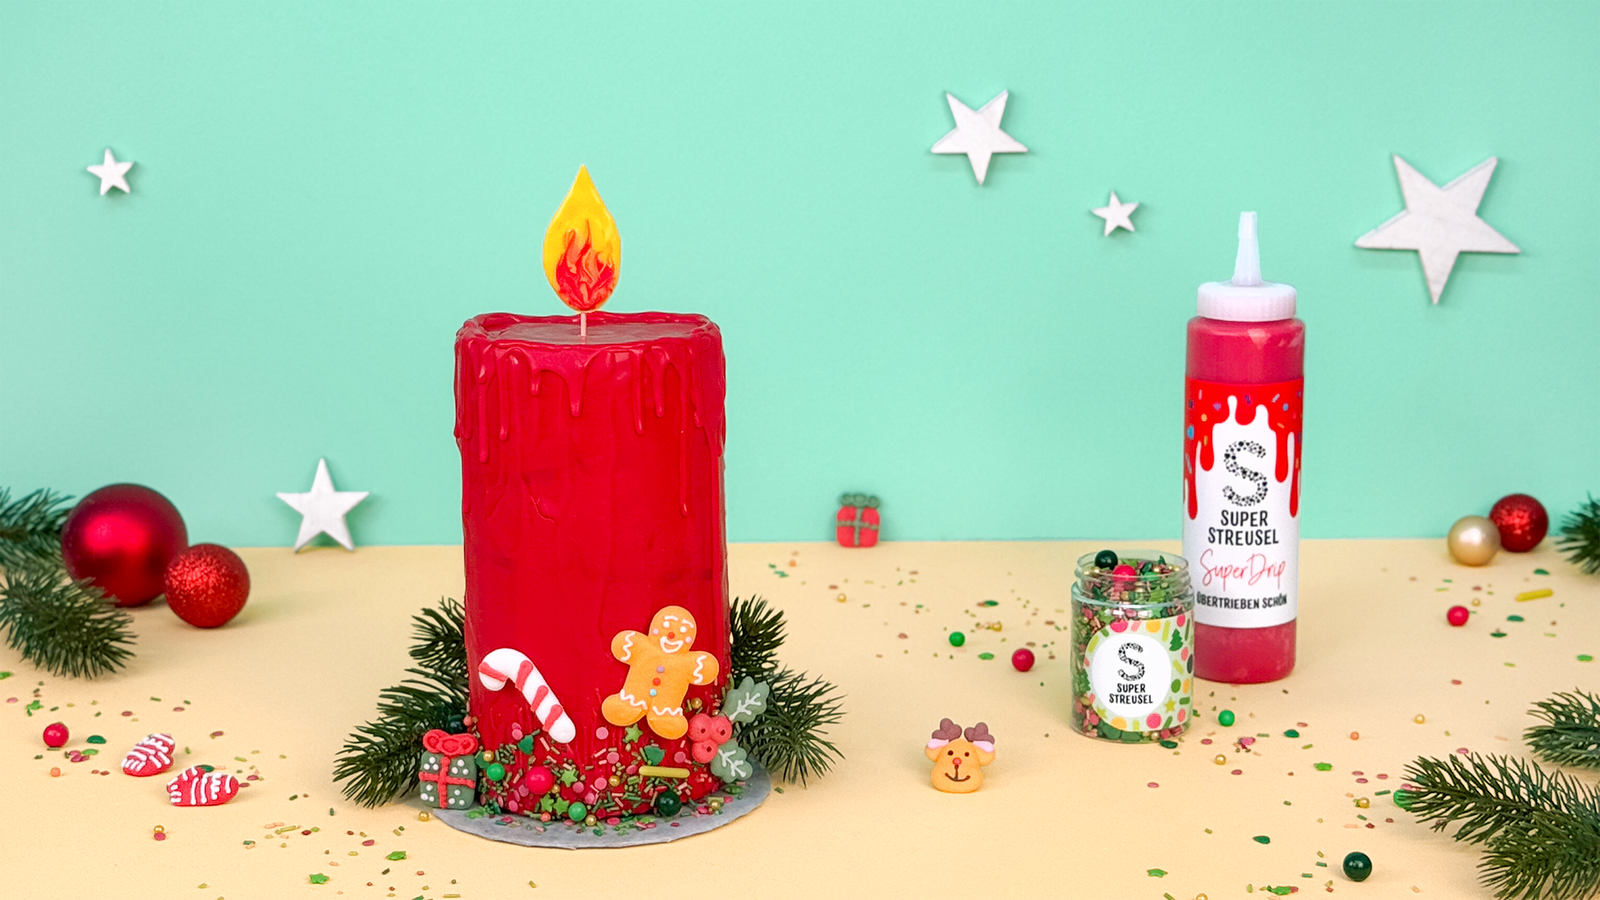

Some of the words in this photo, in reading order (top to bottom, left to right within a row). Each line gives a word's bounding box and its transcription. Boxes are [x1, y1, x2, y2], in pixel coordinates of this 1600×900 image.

[1222, 440, 1268, 507] S
[1221, 509, 1268, 526] SUPER
[1208, 527, 1279, 546] STREUSEL
[1197, 591, 1259, 609] ÜBERTRIEBEN
[1262, 593, 1287, 608] SCHÖN
[1118, 642, 1145, 681] S
[1117, 683, 1146, 693] SUPER
[1109, 693, 1153, 704] STREUSEL
